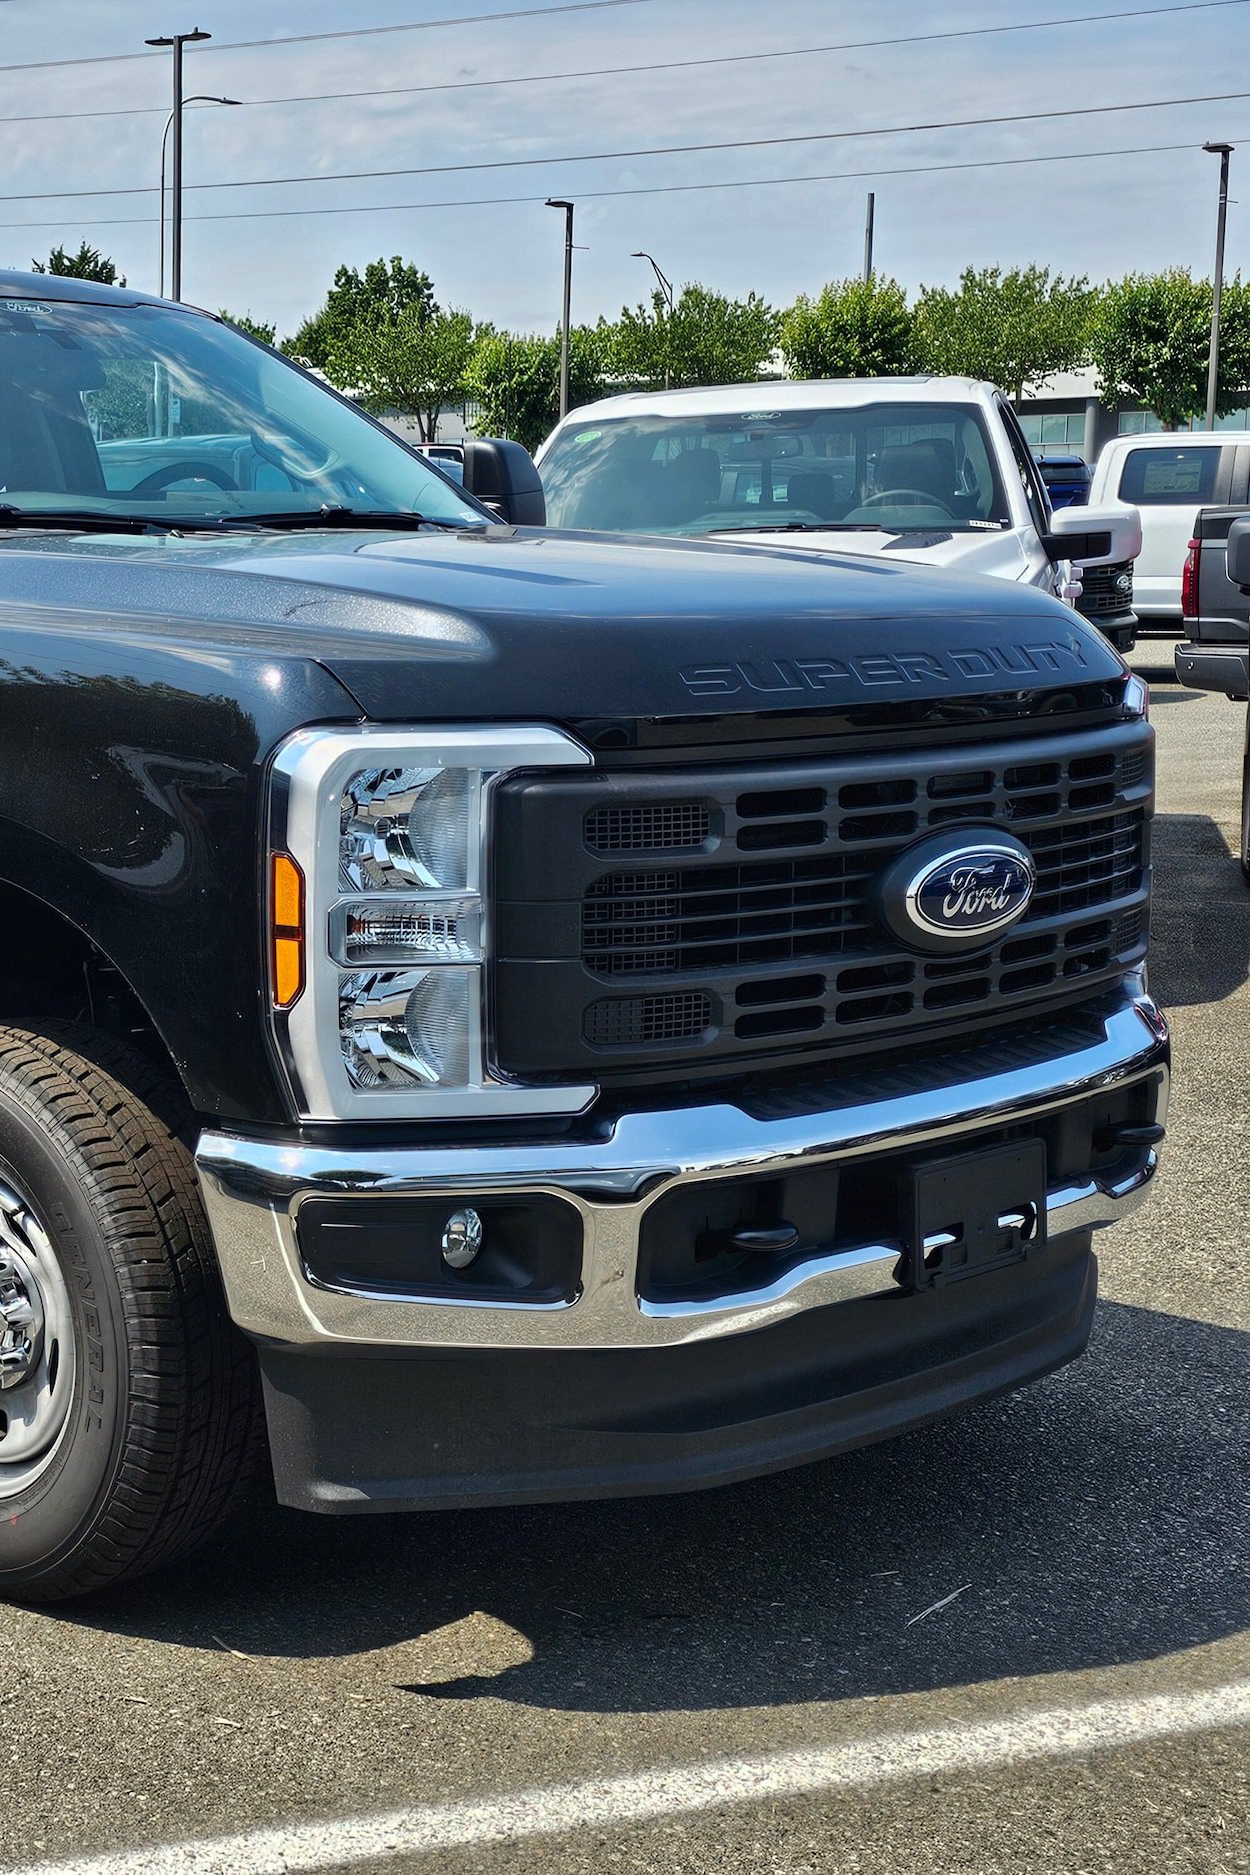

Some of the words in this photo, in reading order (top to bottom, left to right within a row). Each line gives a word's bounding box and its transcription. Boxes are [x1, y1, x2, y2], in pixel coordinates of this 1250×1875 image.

[678, 651, 950, 696] SUPER
[947, 636, 1087, 679] DUTY
[942, 864, 1012, 919] Ford
[51, 1201, 104, 1434] GENERAL
